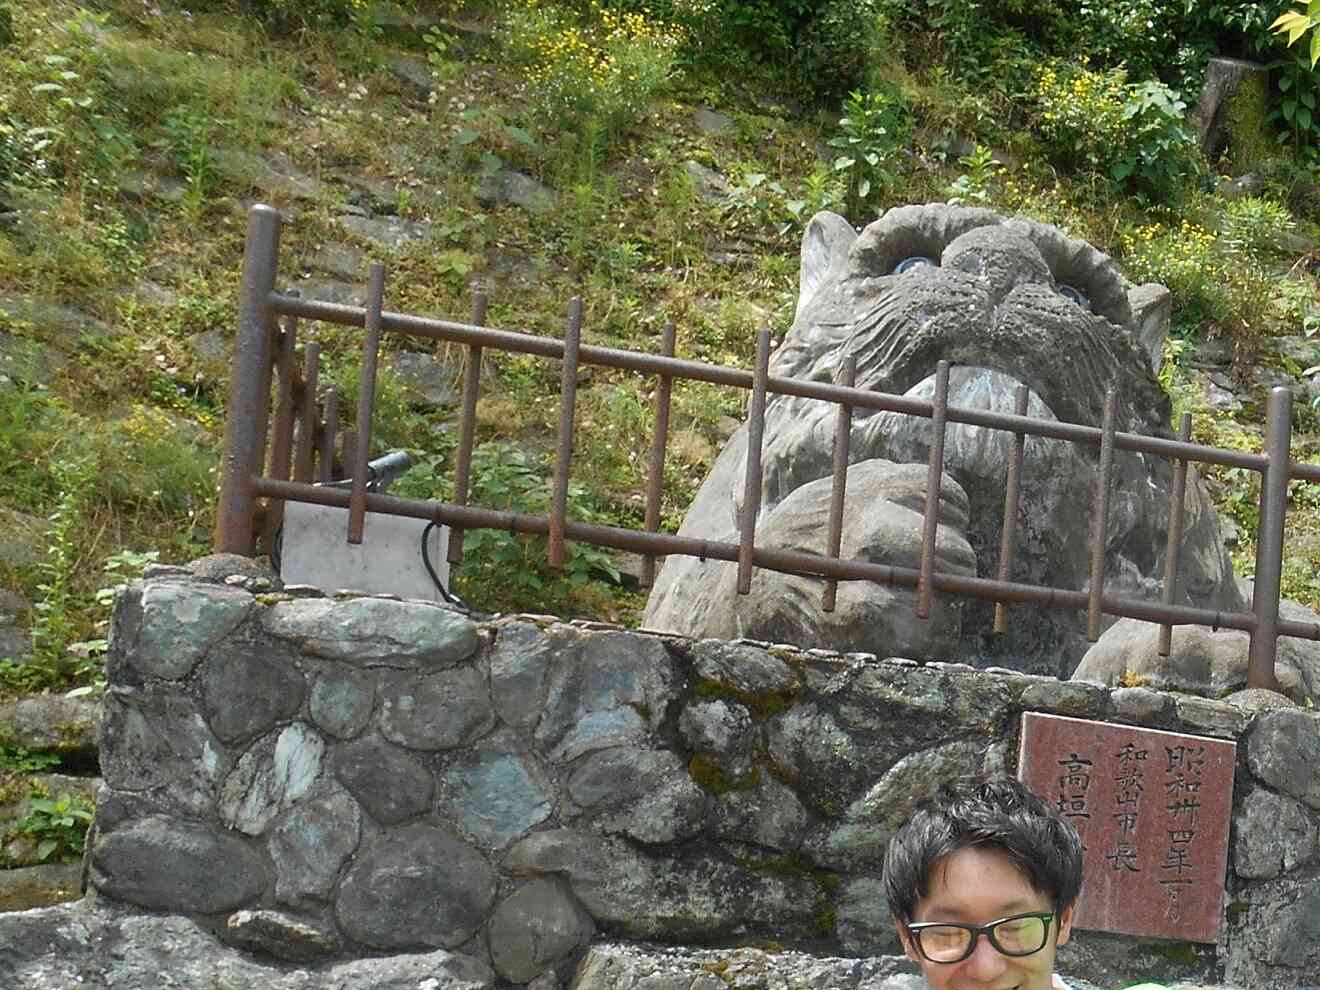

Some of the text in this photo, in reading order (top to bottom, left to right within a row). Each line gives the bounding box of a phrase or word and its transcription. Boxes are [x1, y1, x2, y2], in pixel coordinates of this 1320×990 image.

[1106, 743, 1149, 872] 和歌山市長
